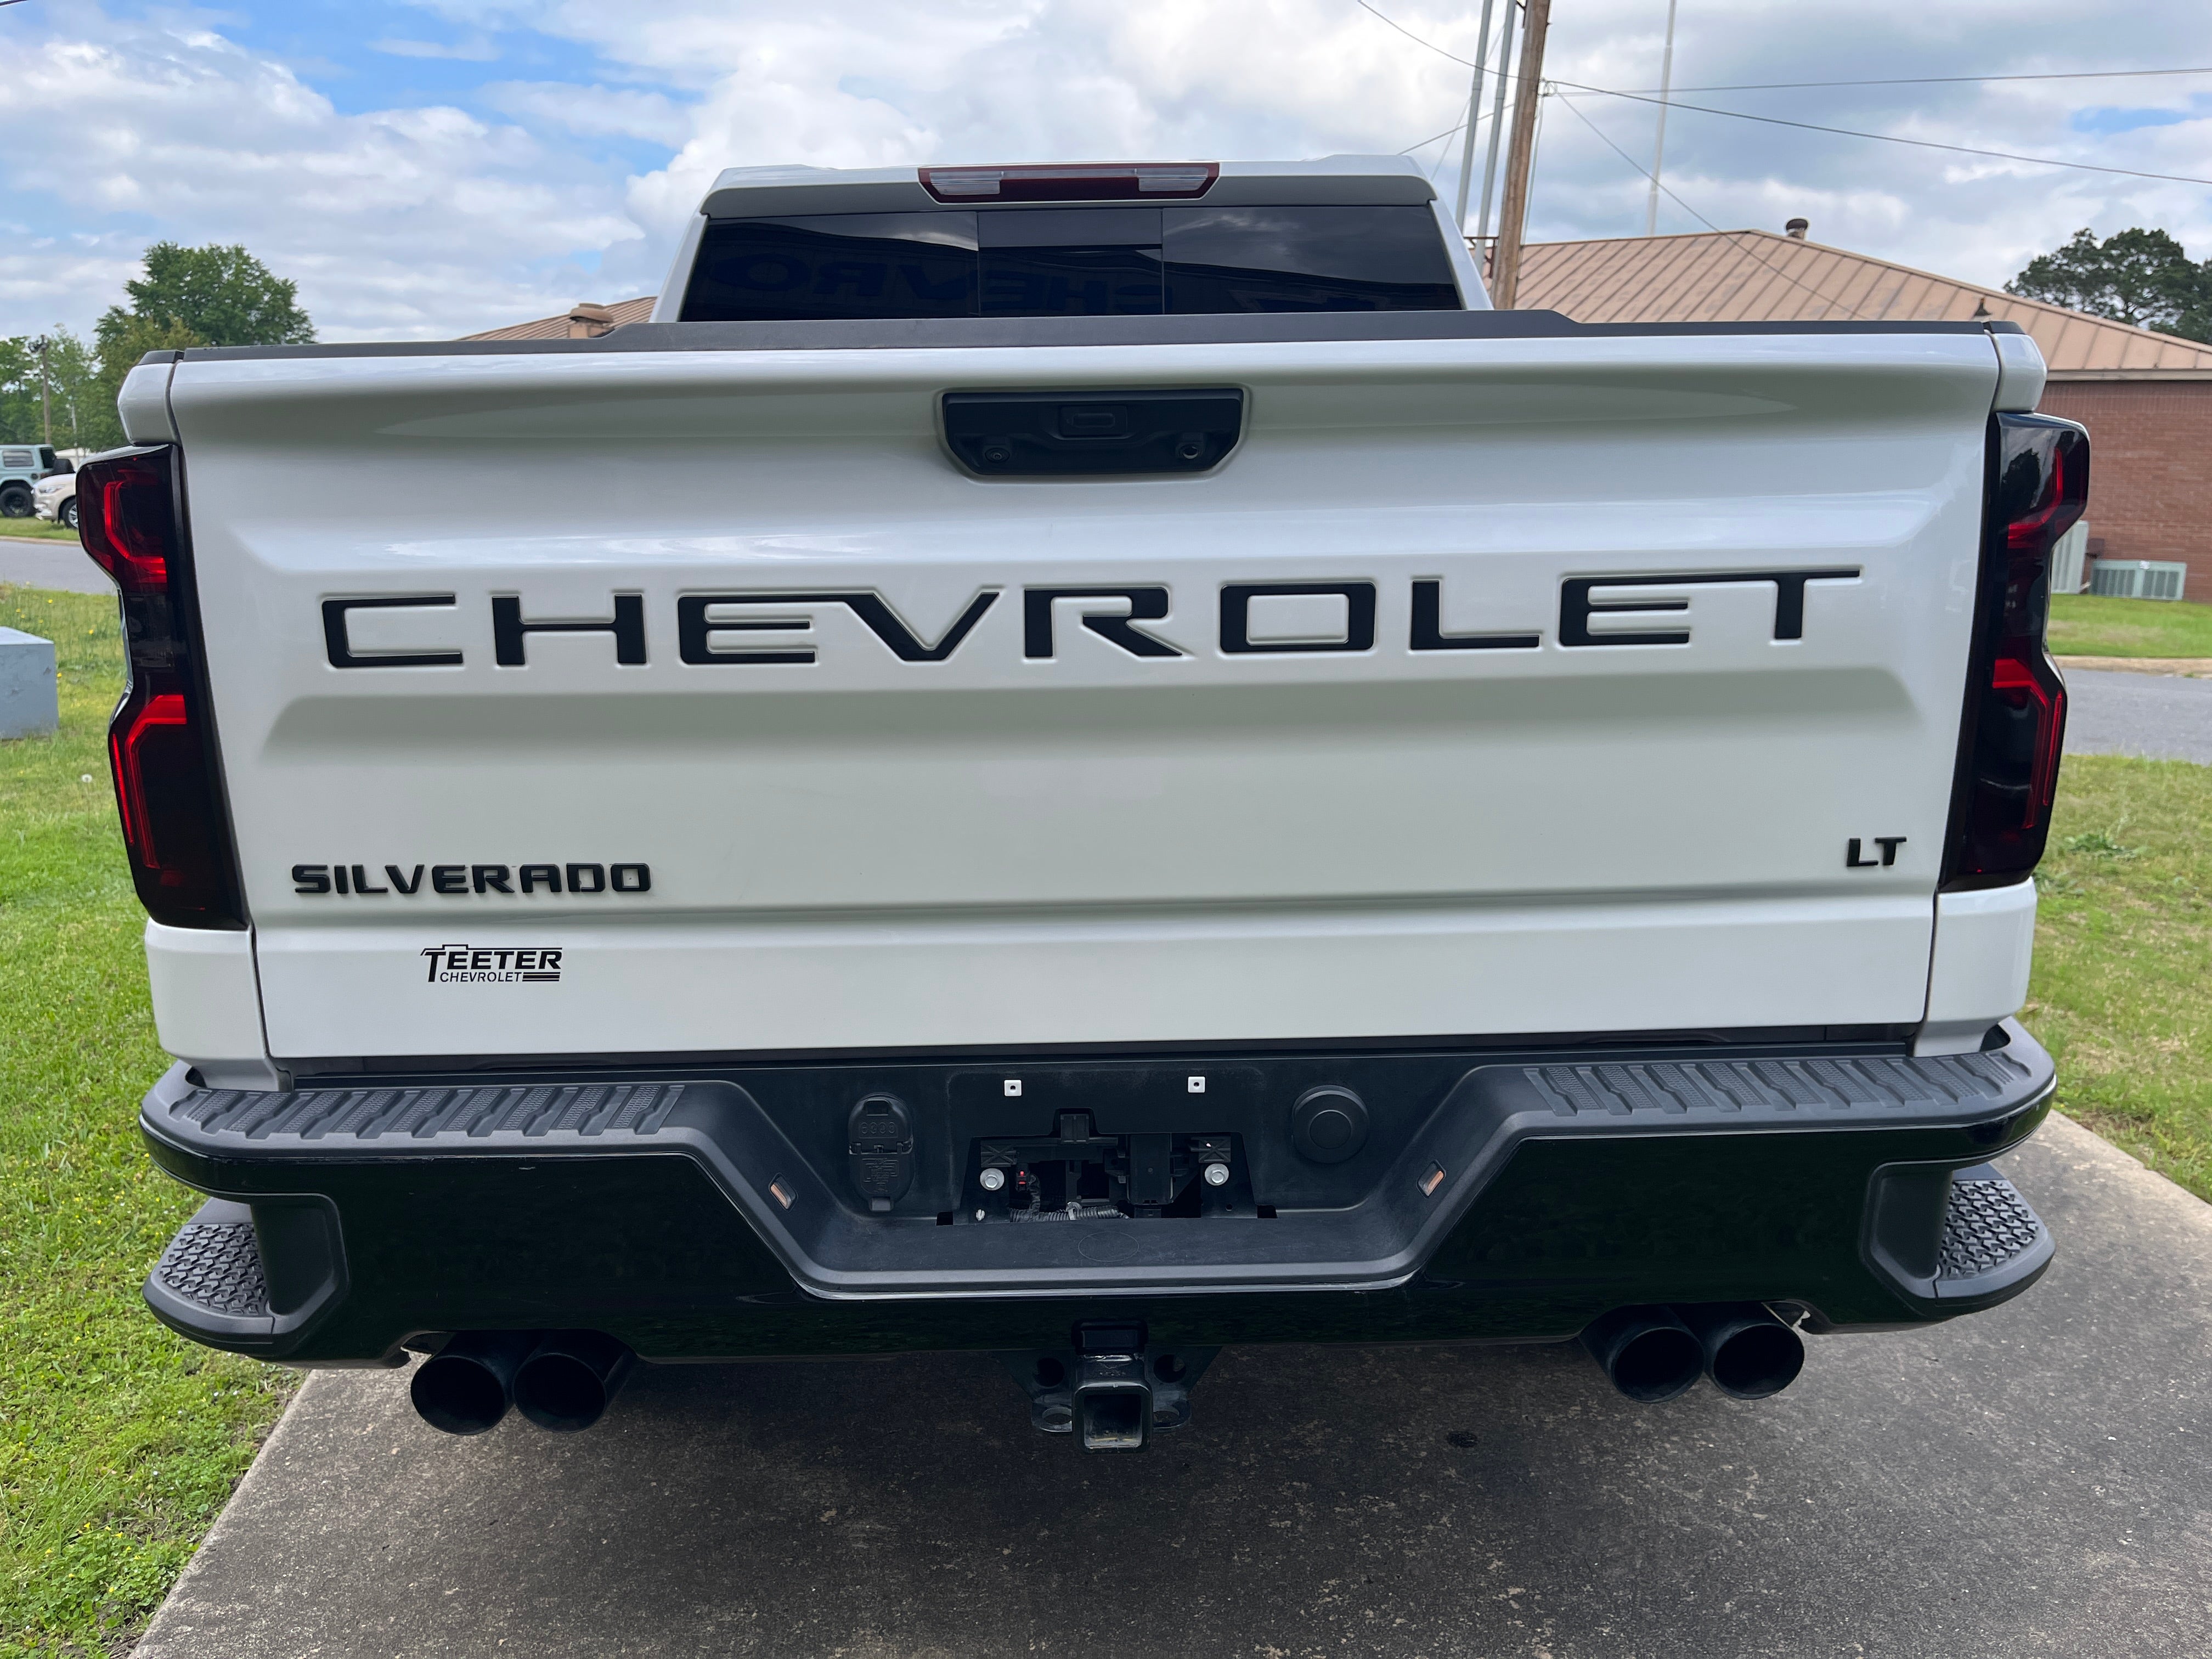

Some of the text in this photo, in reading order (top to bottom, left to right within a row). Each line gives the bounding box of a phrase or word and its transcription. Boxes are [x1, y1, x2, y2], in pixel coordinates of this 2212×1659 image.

[321, 569, 1860, 669] CHEVROLET
[1847, 837, 1907, 867] LT
[292, 863, 651, 894] SILVERADO
[424, 951, 562, 983] TEETER
[439, 972, 522, 983] CHEVROLET
